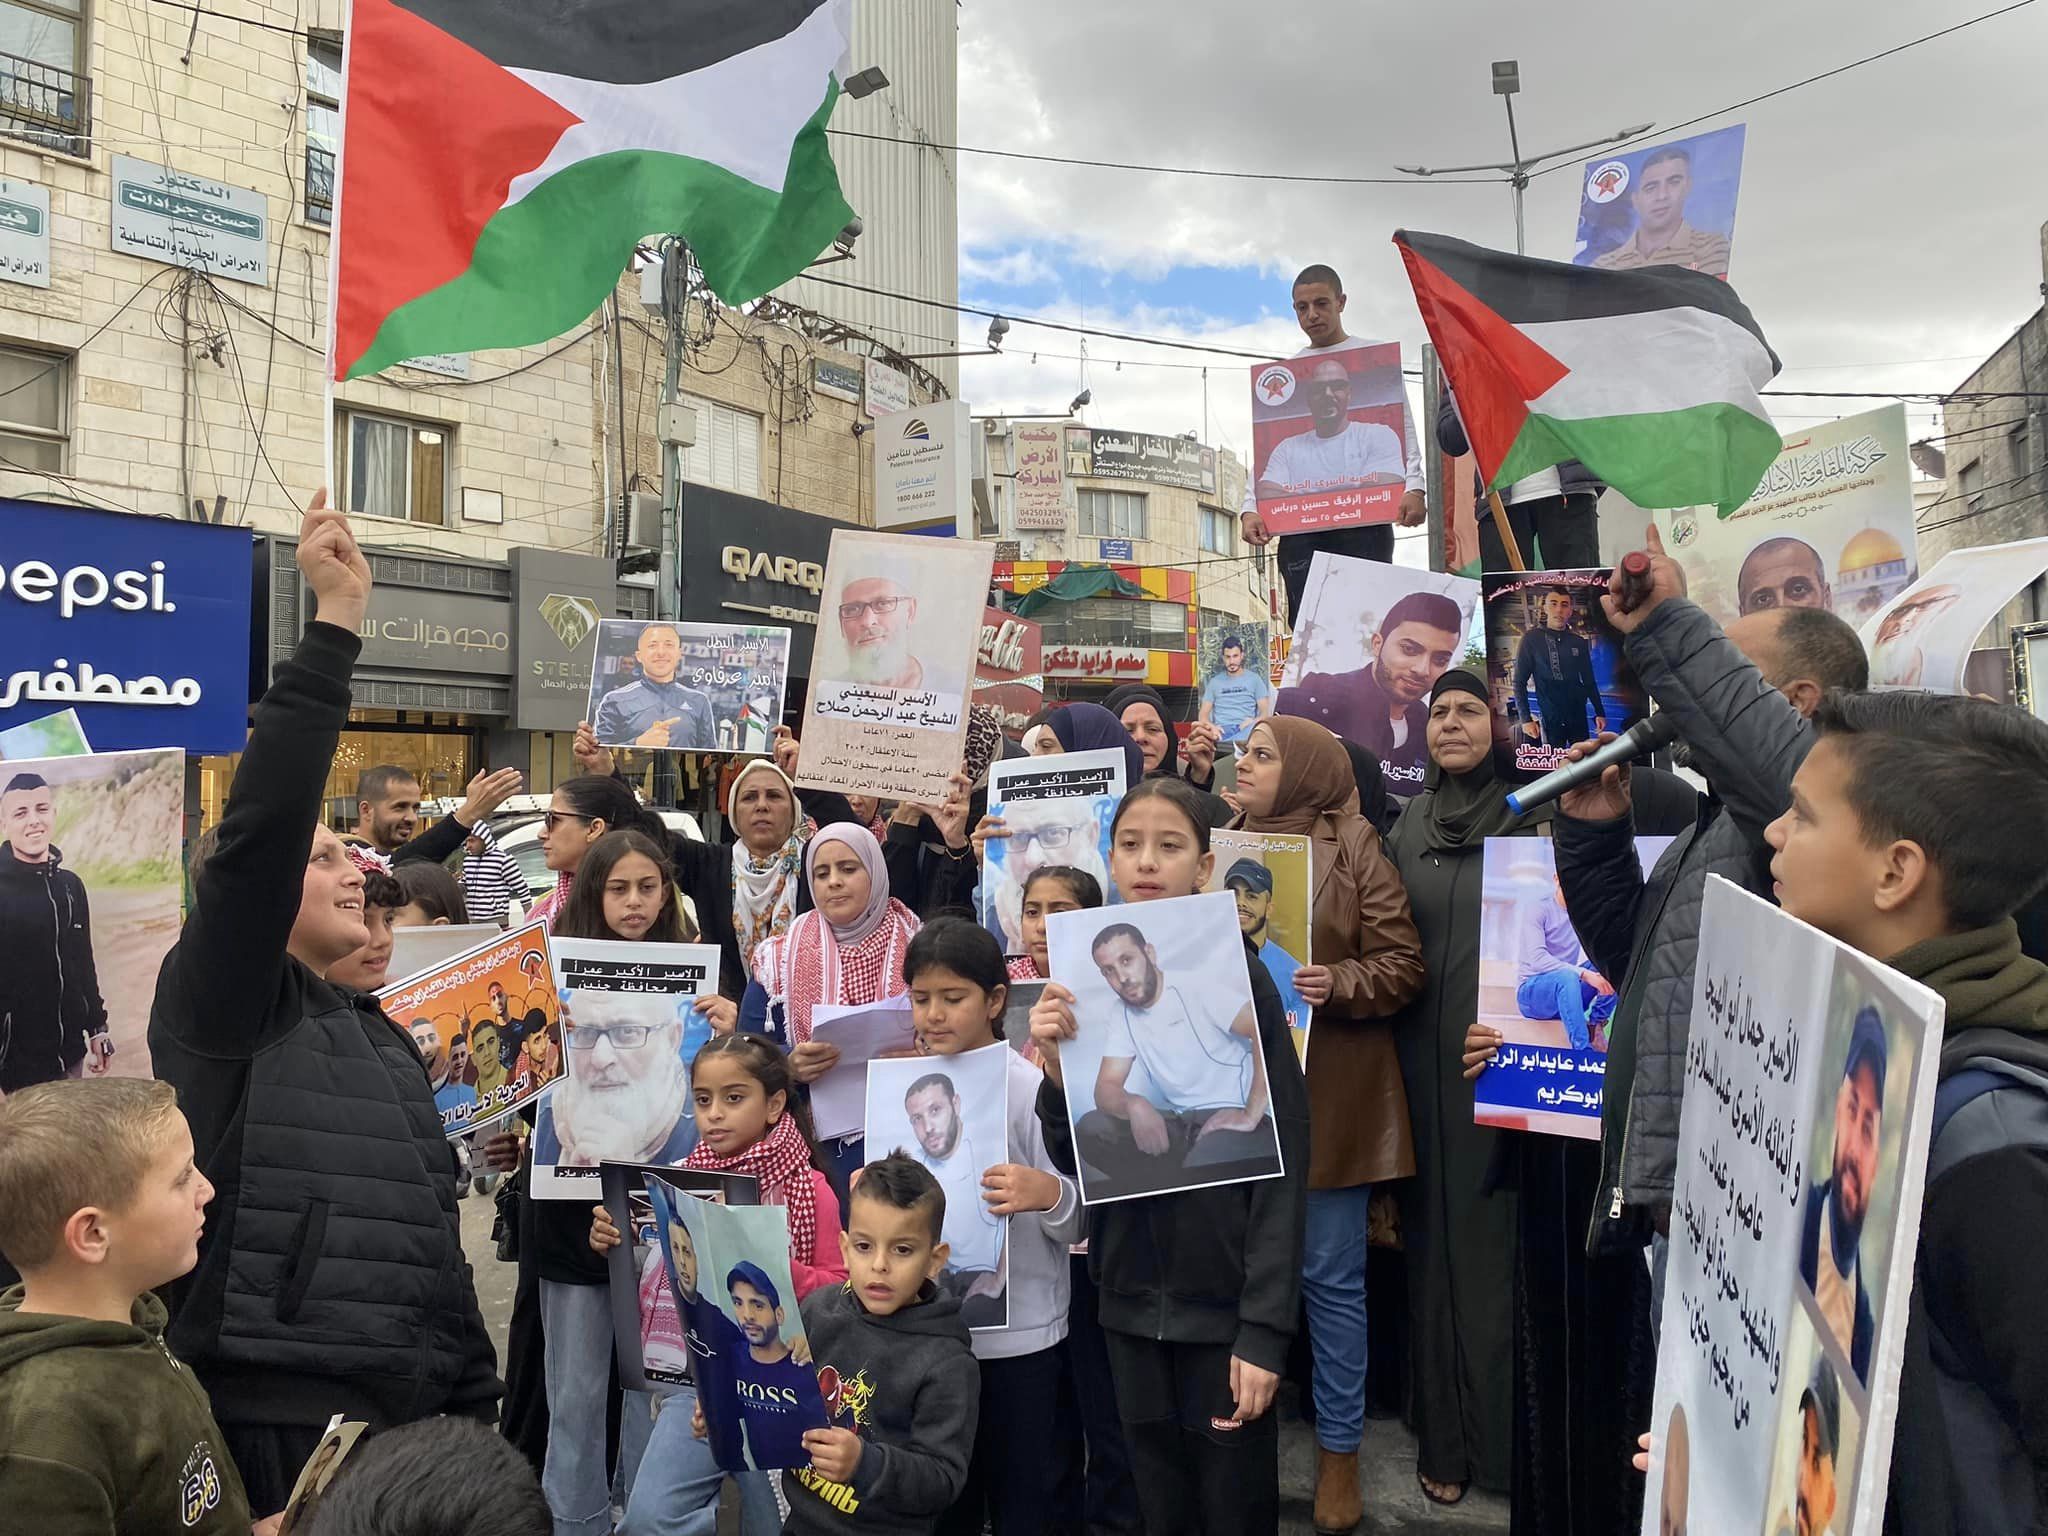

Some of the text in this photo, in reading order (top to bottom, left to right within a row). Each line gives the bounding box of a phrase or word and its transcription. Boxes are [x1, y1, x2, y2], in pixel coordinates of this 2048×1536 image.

[152, 175, 230, 200] الدكتور
[128, 189, 257, 230] حسين جرادات
[119, 226, 261, 272] الامراض الجلدية والتناسلية
[1019, 425, 1057, 442] مكتبة
[1021, 446, 1058, 466] الأرض
[1140, 436, 1172, 460] المختار
[1018, 468, 1062, 488] المباركة
[1271, 501, 1299, 516] درباس
[1302, 498, 1330, 512] حسين
[1333, 493, 1361, 508] الرفيق
[1301, 514, 1318, 525] سنة
[1333, 508, 1361, 521] الحكم
[722, 545, 823, 596] QARQ
[382, 616, 510, 652] مجوهرات
[706, 632, 735, 650] البطل
[533, 660, 590, 679] STELL
[1043, 646, 1146, 675] مطعم فرايد تشكن
[748, 664, 778, 688] أمير
[839, 685, 937, 707] الأسير السبعيني
[815, 700, 957, 726] الشيخ عبد الرحمن صلاح
[820, 755, 851, 769] الاحتلال
[1516, 743, 1551, 759] البطل
[895, 784, 917, 795] صفقة
[1010, 784, 1106, 801] في محافظة جنين
[614, 964, 650, 979] الأكبر
[577, 978, 693, 994] في محافظة جنين
[1724, 975, 1742, 1041] أبو
[1738, 996, 1765, 1063] جمال
[1764, 1018, 1800, 1086] الأسير
[497, 1073, 530, 1103] الحرية
[1732, 1084, 1765, 1148] الأسرى
[1733, 1191, 1763, 1242] عاصم
[1717, 1236, 1739, 1302] حمزة
[1741, 1288, 1781, 1396] والشهيد
